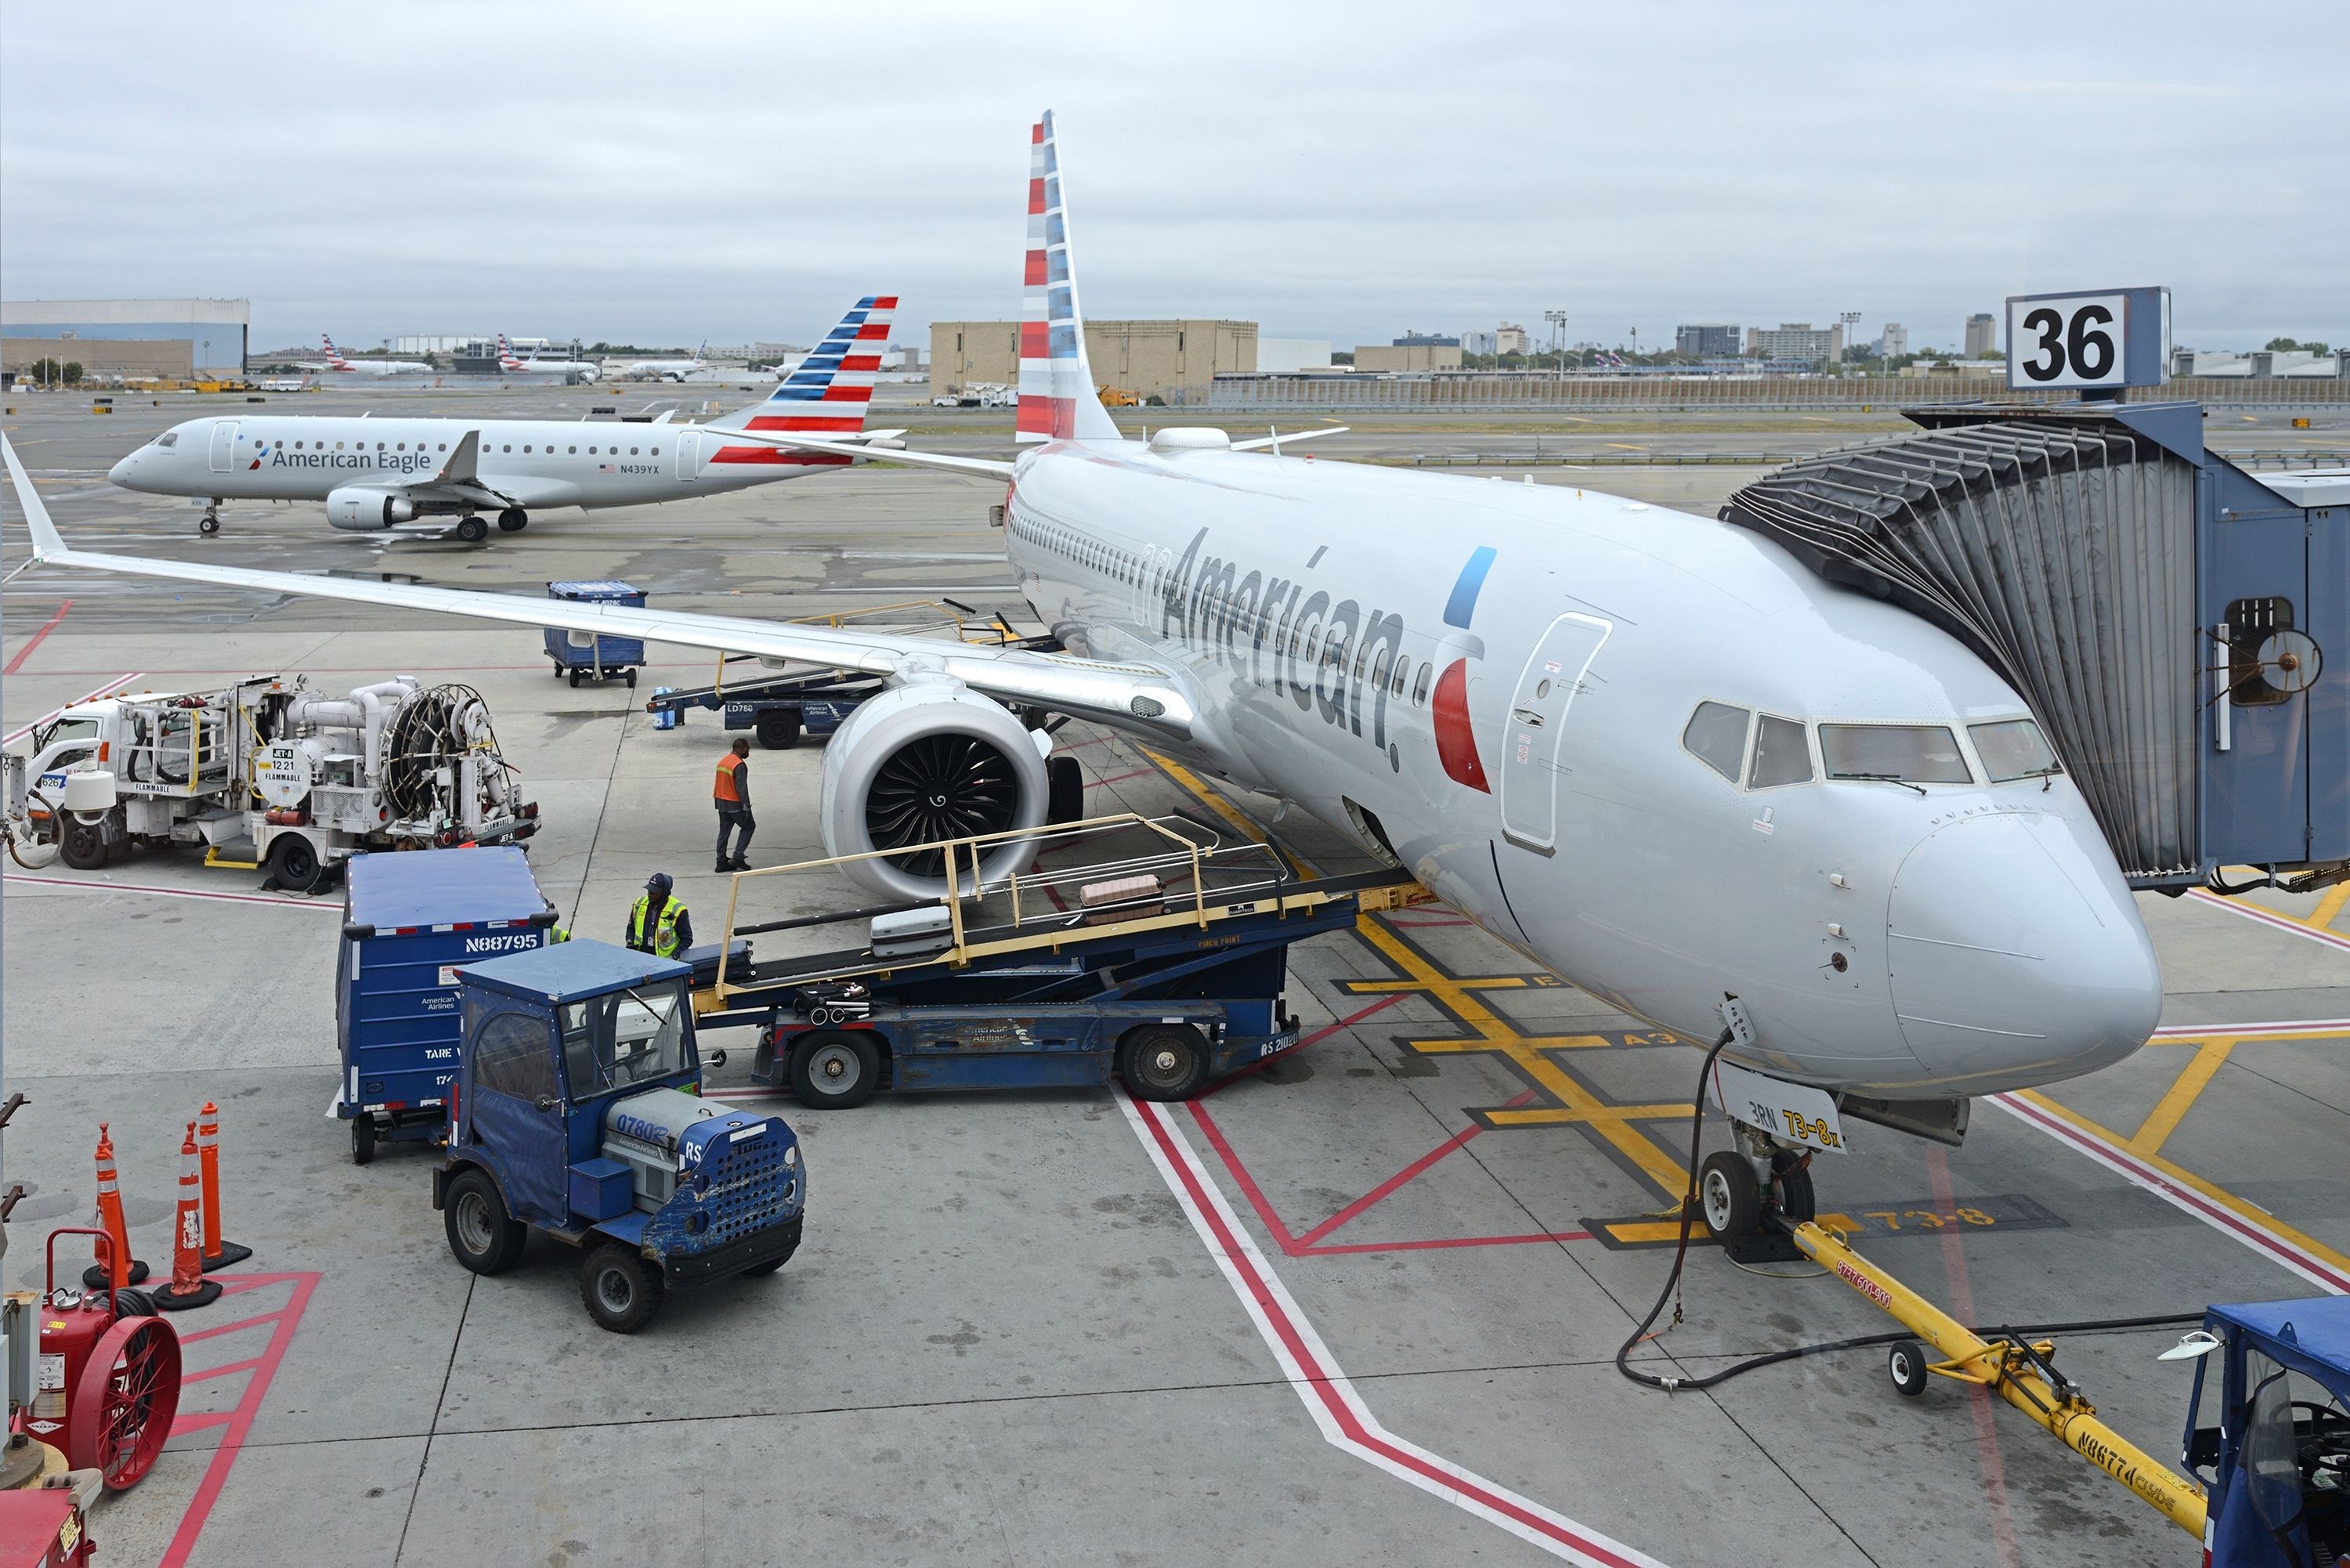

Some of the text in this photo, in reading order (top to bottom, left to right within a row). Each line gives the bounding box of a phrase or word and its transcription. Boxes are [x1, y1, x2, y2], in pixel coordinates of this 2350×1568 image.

[2023, 305, 2115, 381] 36
[273, 450, 431, 474] American Eagle
[620, 465, 659, 474] N439YX
[1162, 526, 1404, 750] American
[42, 778, 59, 787] 626
[136, 783, 170, 793] FLAMMABLE
[265, 773, 301, 782] FLAMMABLE
[485, 818, 510, 831] FLAMMABLE
[466, 934, 537, 952] N88795
[425, 1048, 452, 1059] TARE
[1261, 1033, 1298, 1057] RS 21020
[1749, 1100, 1779, 1132] 3RN
[685, 1140, 703, 1162] RS
[1864, 1207, 1995, 1230] 73-8
[1837, 1260, 1891, 1309] B737 600-900
